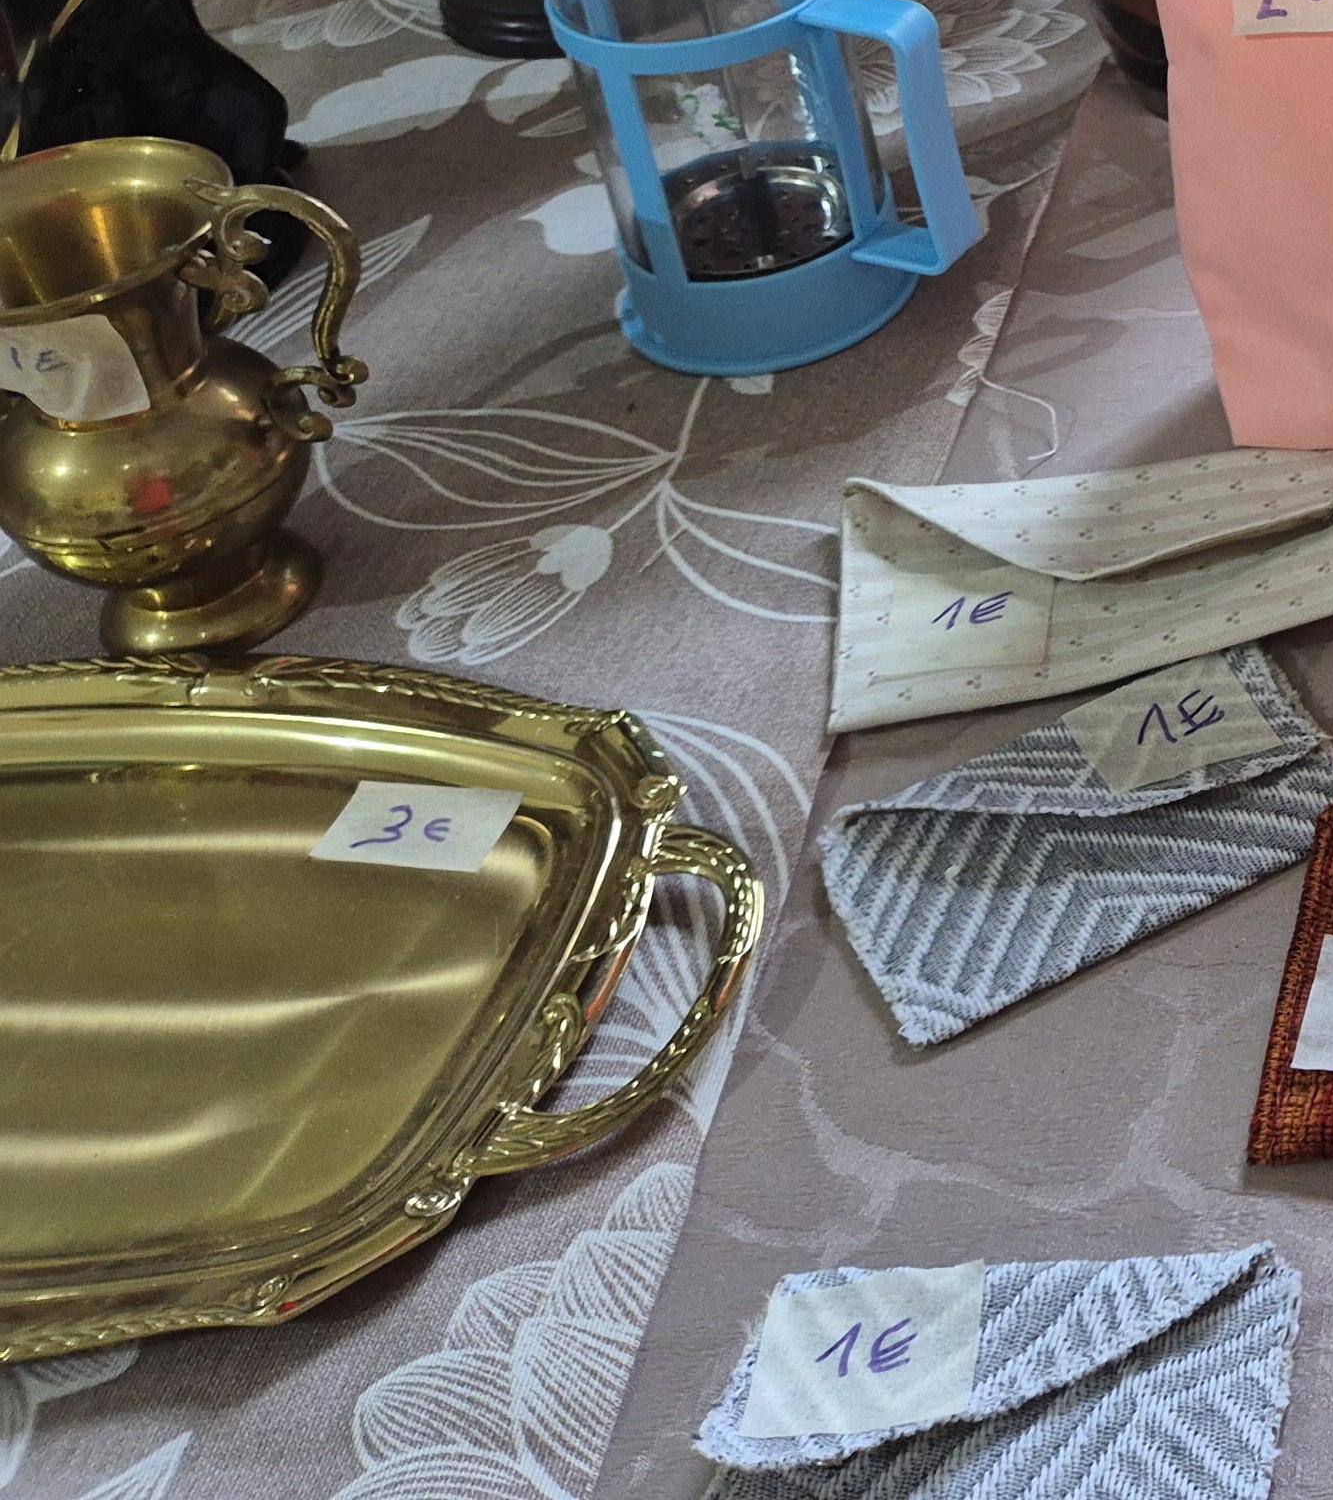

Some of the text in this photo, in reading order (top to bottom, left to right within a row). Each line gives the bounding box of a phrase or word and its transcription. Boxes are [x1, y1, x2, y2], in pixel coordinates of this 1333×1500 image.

[931, 591, 1012, 631] 1€
[1138, 689, 1226, 746] 1€
[350, 804, 452, 849] 3€
[815, 1318, 919, 1378] 1€
